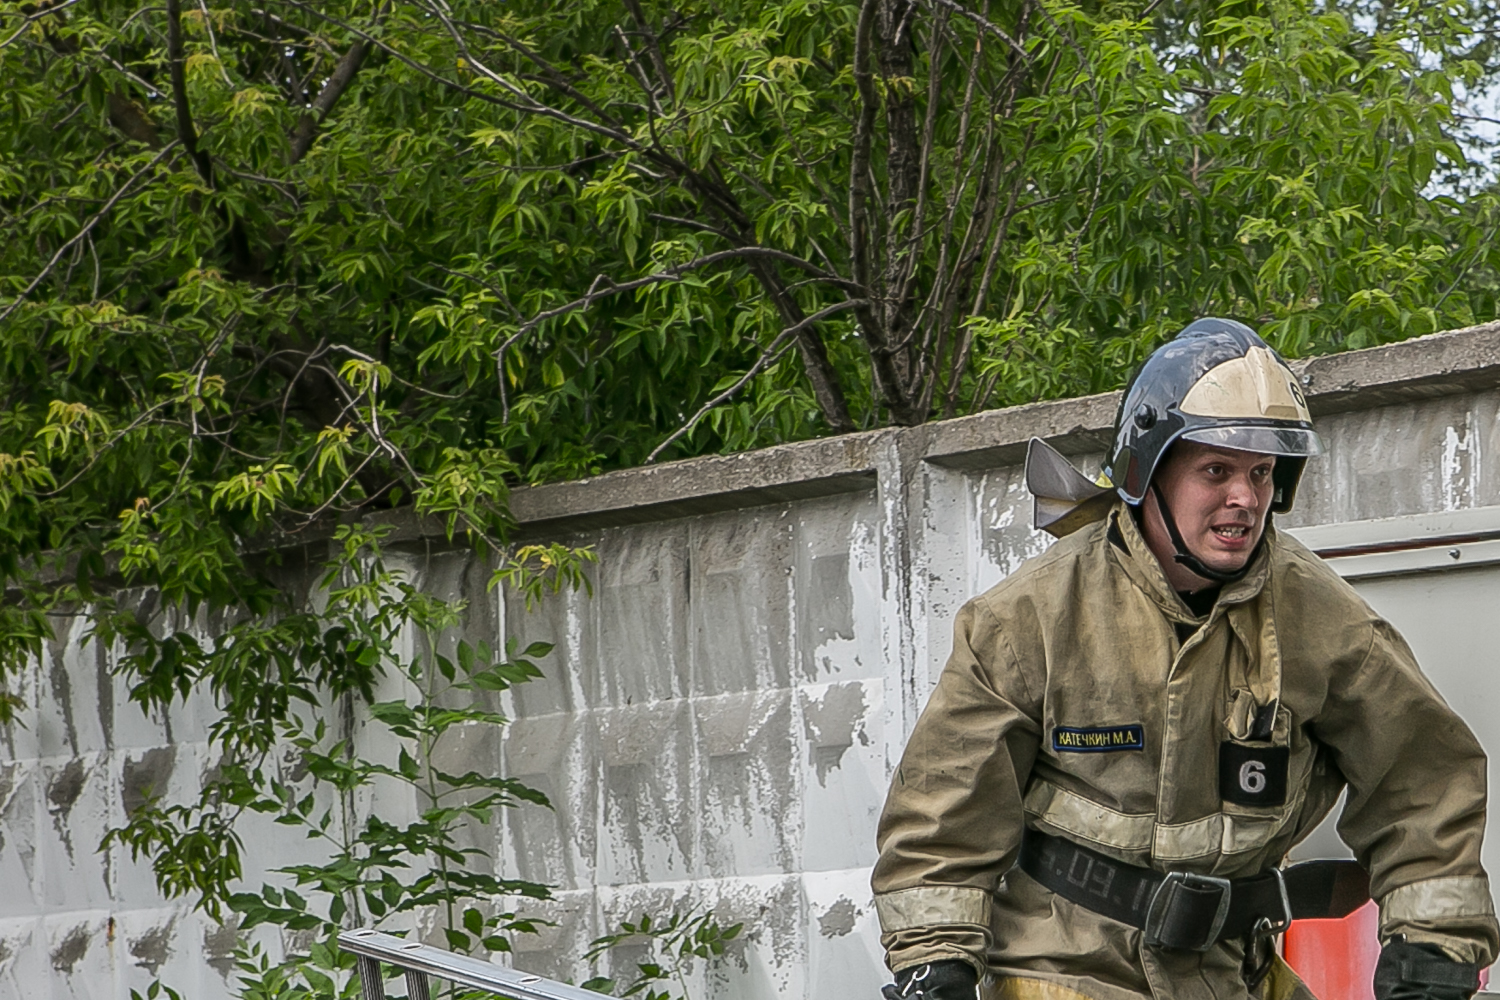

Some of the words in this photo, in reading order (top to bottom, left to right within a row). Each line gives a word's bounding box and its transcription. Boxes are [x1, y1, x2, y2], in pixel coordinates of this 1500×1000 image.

[1290, 382, 1305, 408] 6
[1058, 731, 1111, 747] КАТЕЧКИН
[1239, 759, 1266, 794] 6
